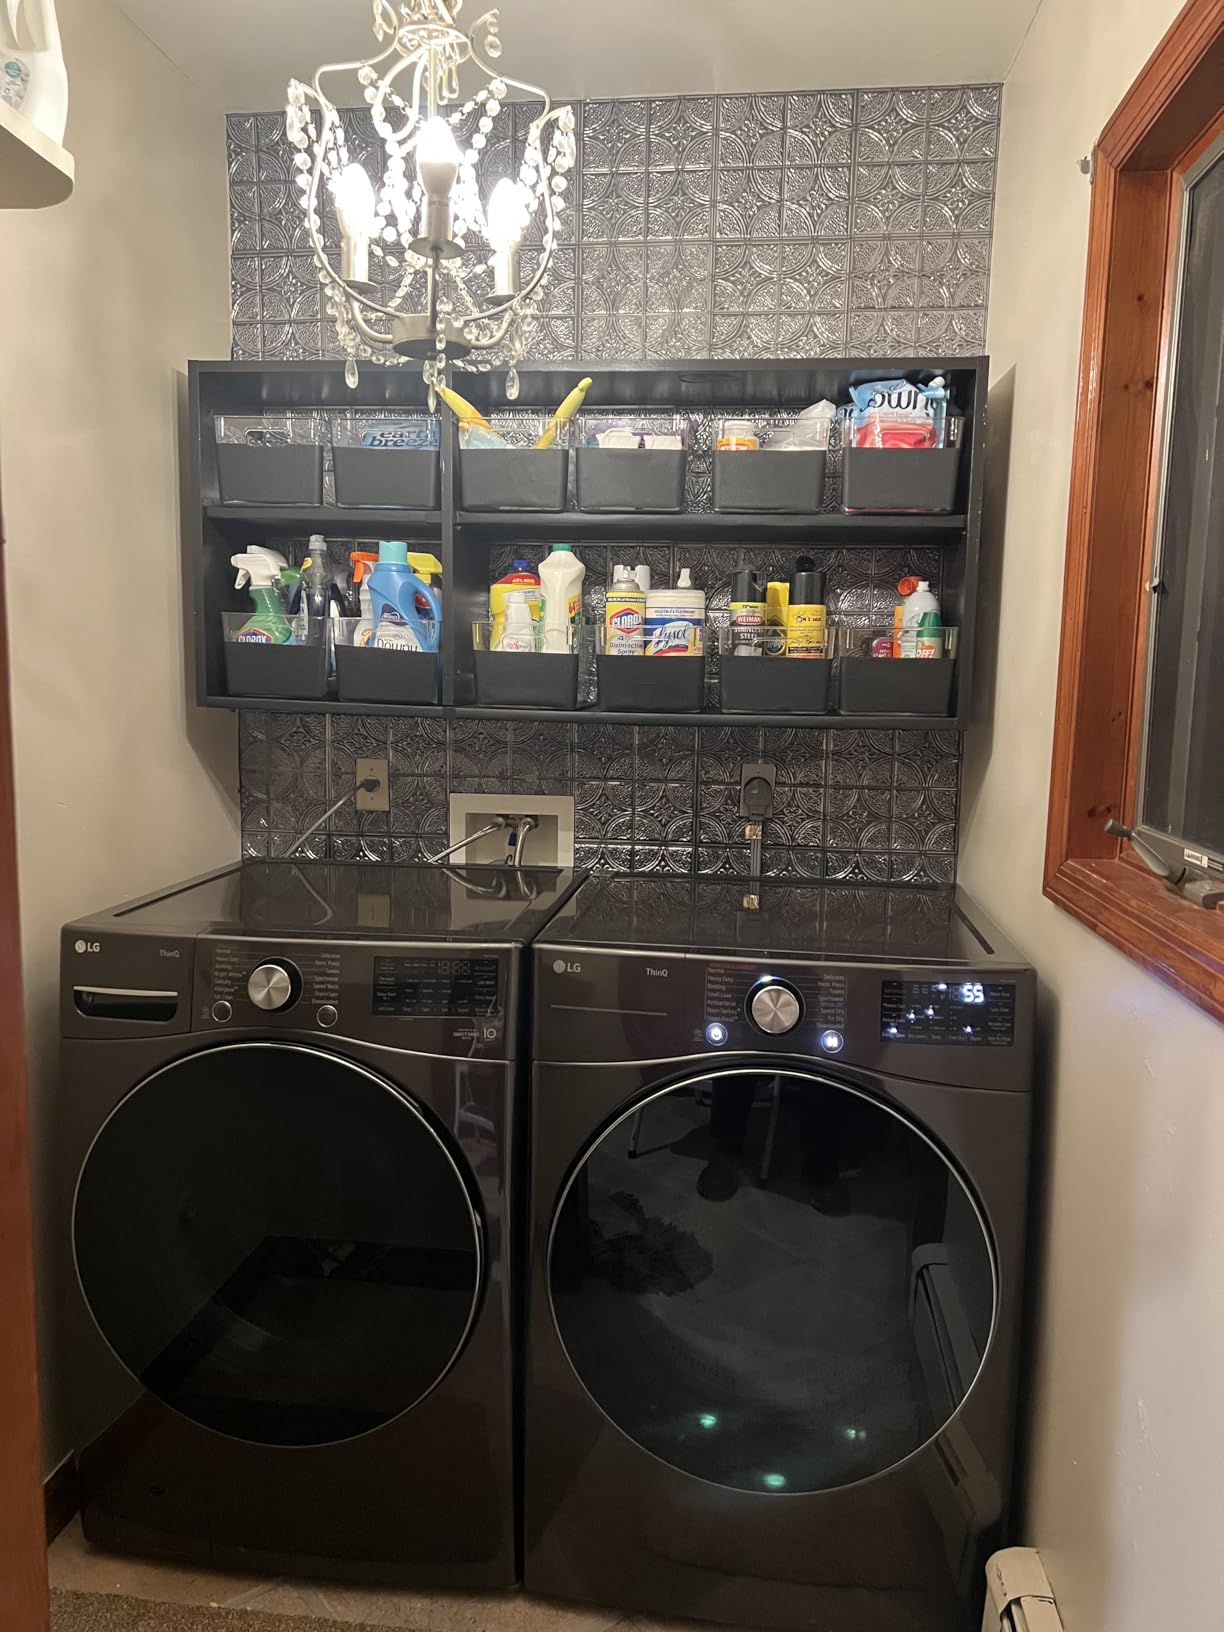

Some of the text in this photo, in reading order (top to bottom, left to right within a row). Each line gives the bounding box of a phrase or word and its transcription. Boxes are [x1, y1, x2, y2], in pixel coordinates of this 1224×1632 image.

[370, 436, 439, 447] breeze
[654, 624, 689, 648] Lysol
[917, 648, 935, 658] OFF!
[160, 949, 180, 958] ThinQ
[646, 967, 669, 977] ThinQ
